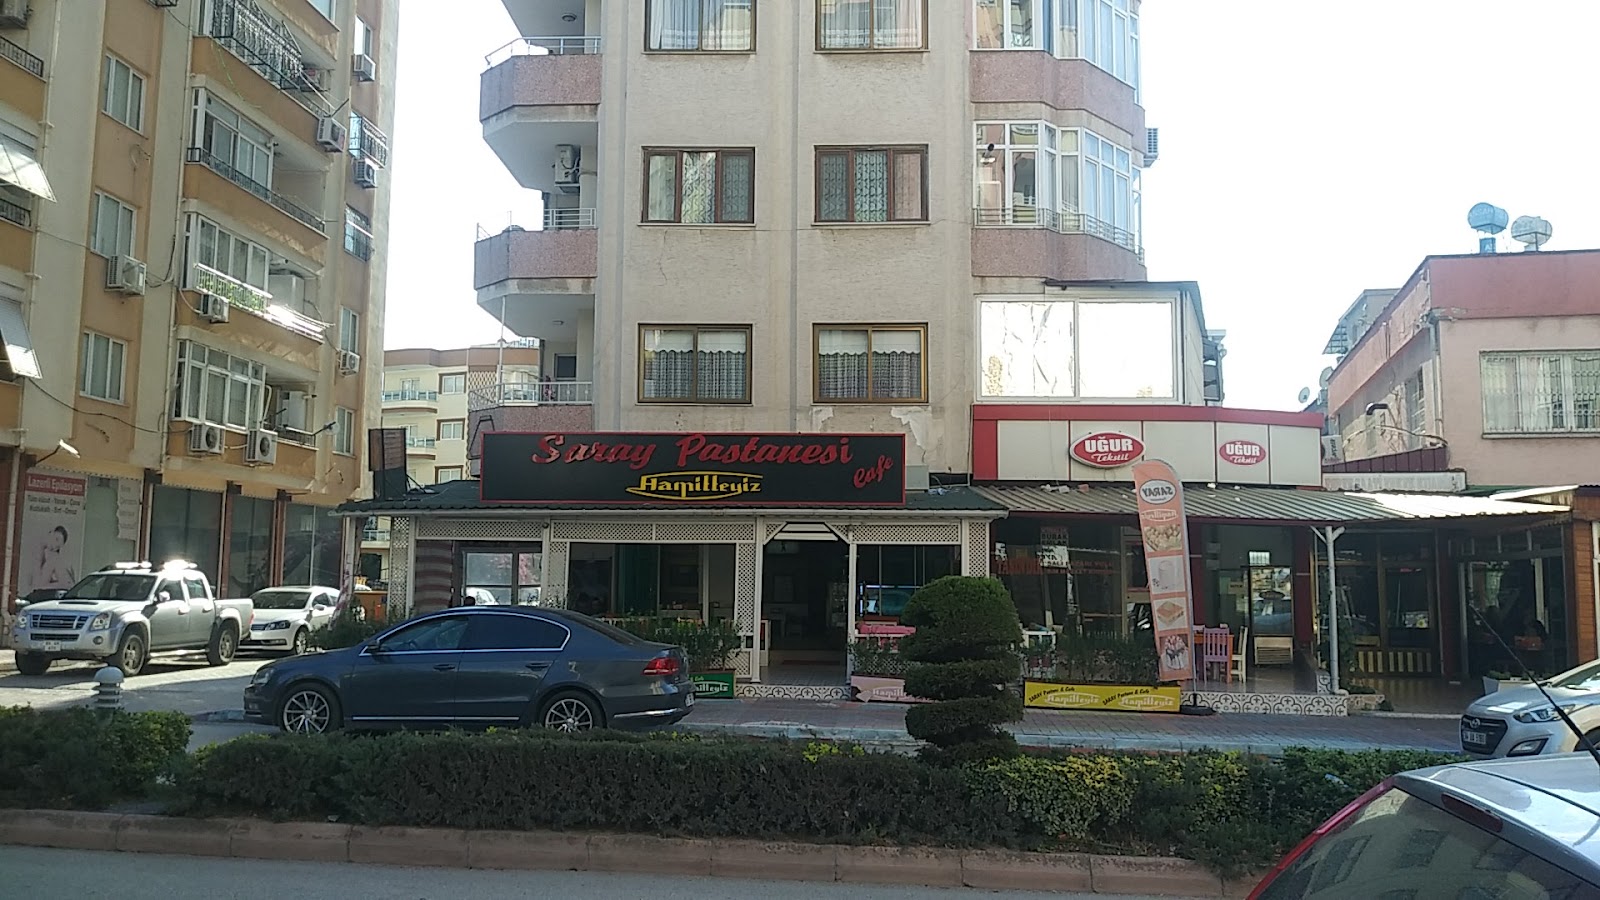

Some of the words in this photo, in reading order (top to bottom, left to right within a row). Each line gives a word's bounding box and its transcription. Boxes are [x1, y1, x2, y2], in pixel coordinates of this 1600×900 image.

[531, 434, 656, 469] Saray
[676, 434, 853, 467] Pastanesi
[1084, 436, 1133, 453] UĞUR
[1225, 442, 1260, 456] UĞUR
[1090, 453, 1129, 462] Tekstil
[853, 455, 893, 488] Cafe
[51, 479, 83, 494] Epilasyon
